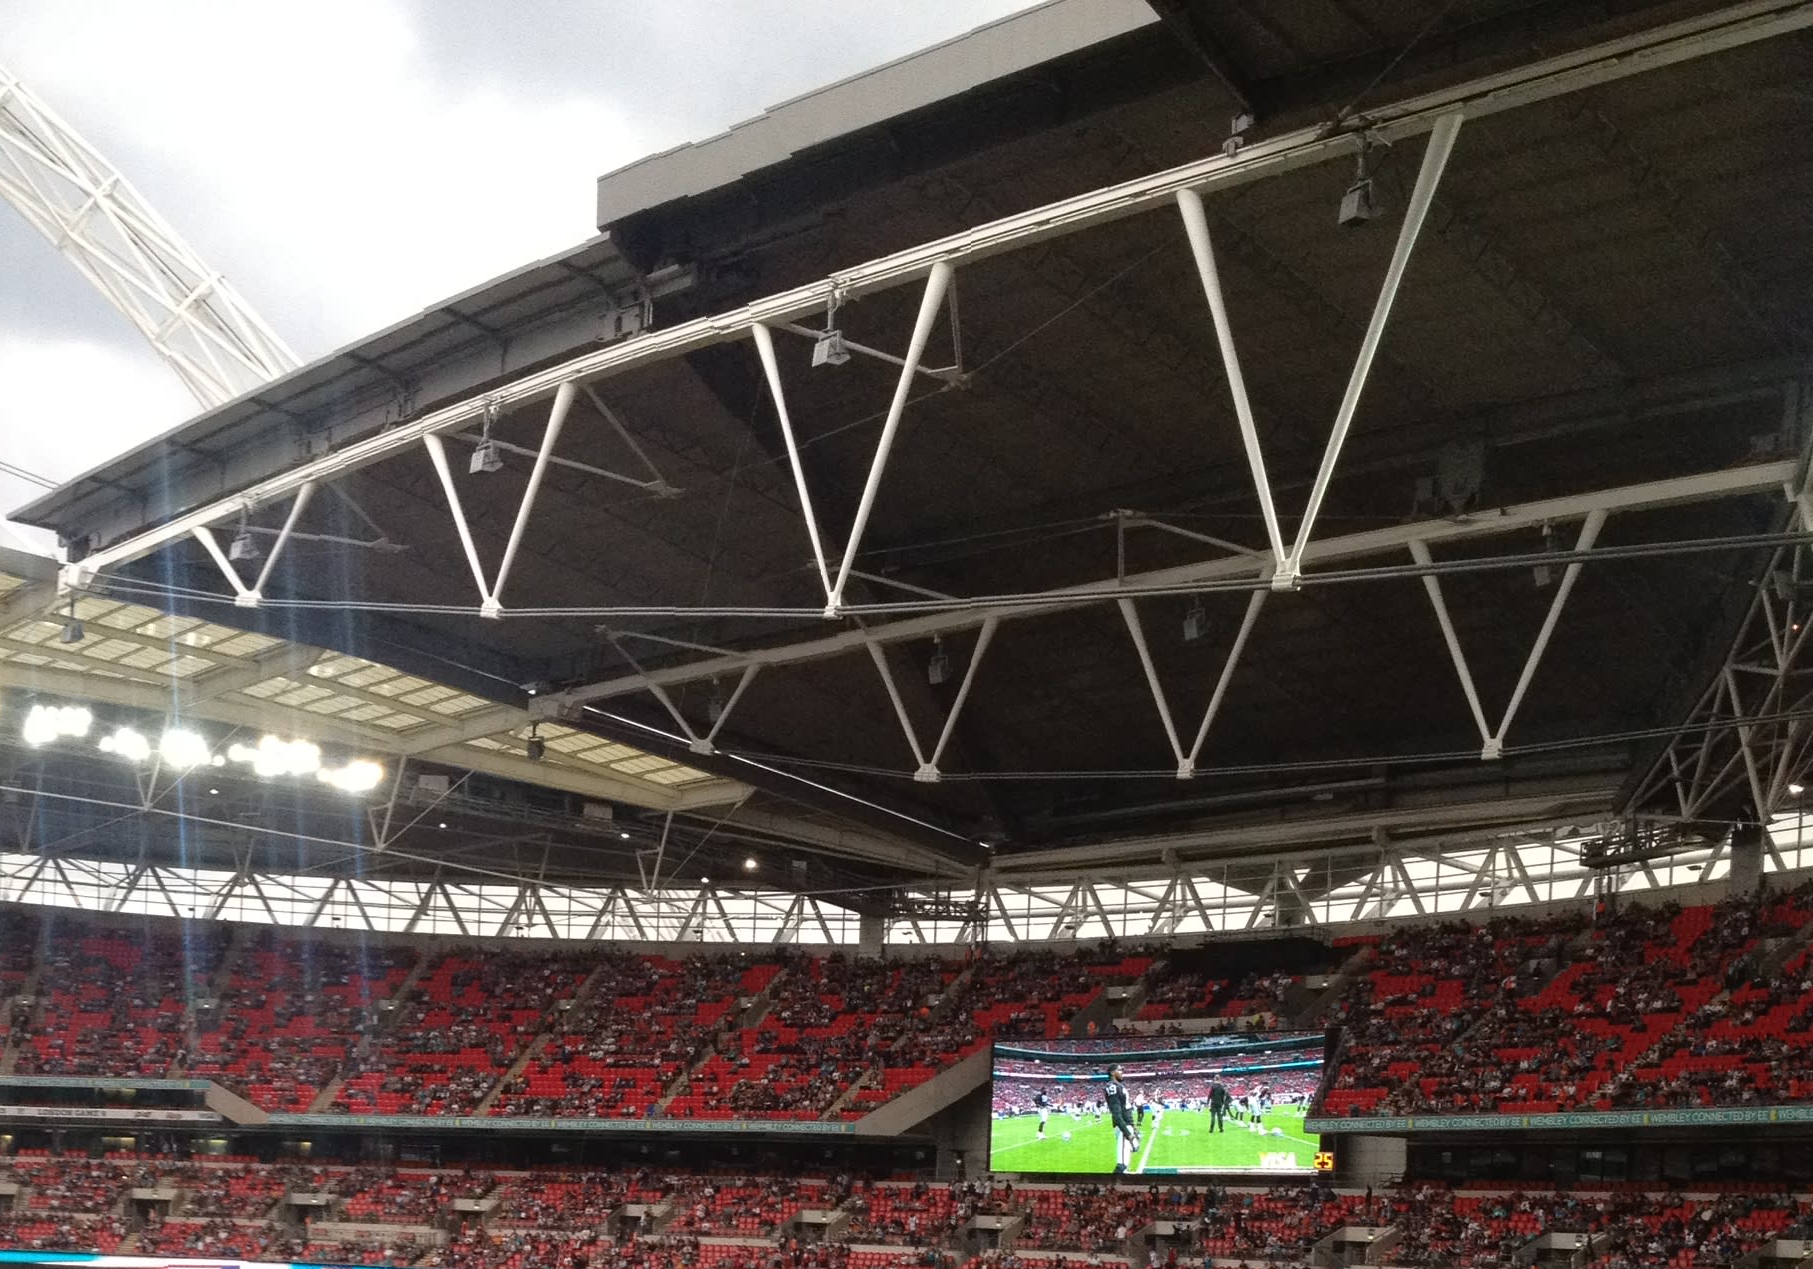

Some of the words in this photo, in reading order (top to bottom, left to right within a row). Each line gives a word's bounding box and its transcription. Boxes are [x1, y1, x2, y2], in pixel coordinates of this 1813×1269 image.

[1415, 1117, 1447, 1129] WEMBLEY
[1448, 1117, 1499, 1128] CONNECTED
[1499, 1116, 1510, 1127] BY
[1511, 1116, 1522, 1126] EE
[1530, 1116, 1567, 1127] WEMBLEY
[1570, 1115, 1620, 1126] CONNECTED
[1621, 1115, 1631, 1125] BY
[1632, 1114, 1641, 1124] EE
[1651, 1112, 1691, 1123] WEMBLEY
[1693, 1111, 1744, 1122] CONNECTED
[1745, 1111, 1757, 1121] BY
[1758, 1110, 1768, 1120] EE
[1340, 1119, 1385, 1130] CONNECTED
[1386, 1118, 1395, 1129] BY
[1396, 1117, 1406, 1128] EE
[1259, 1152, 1297, 1168] VISA
[1314, 1153, 1332, 1168] 25
